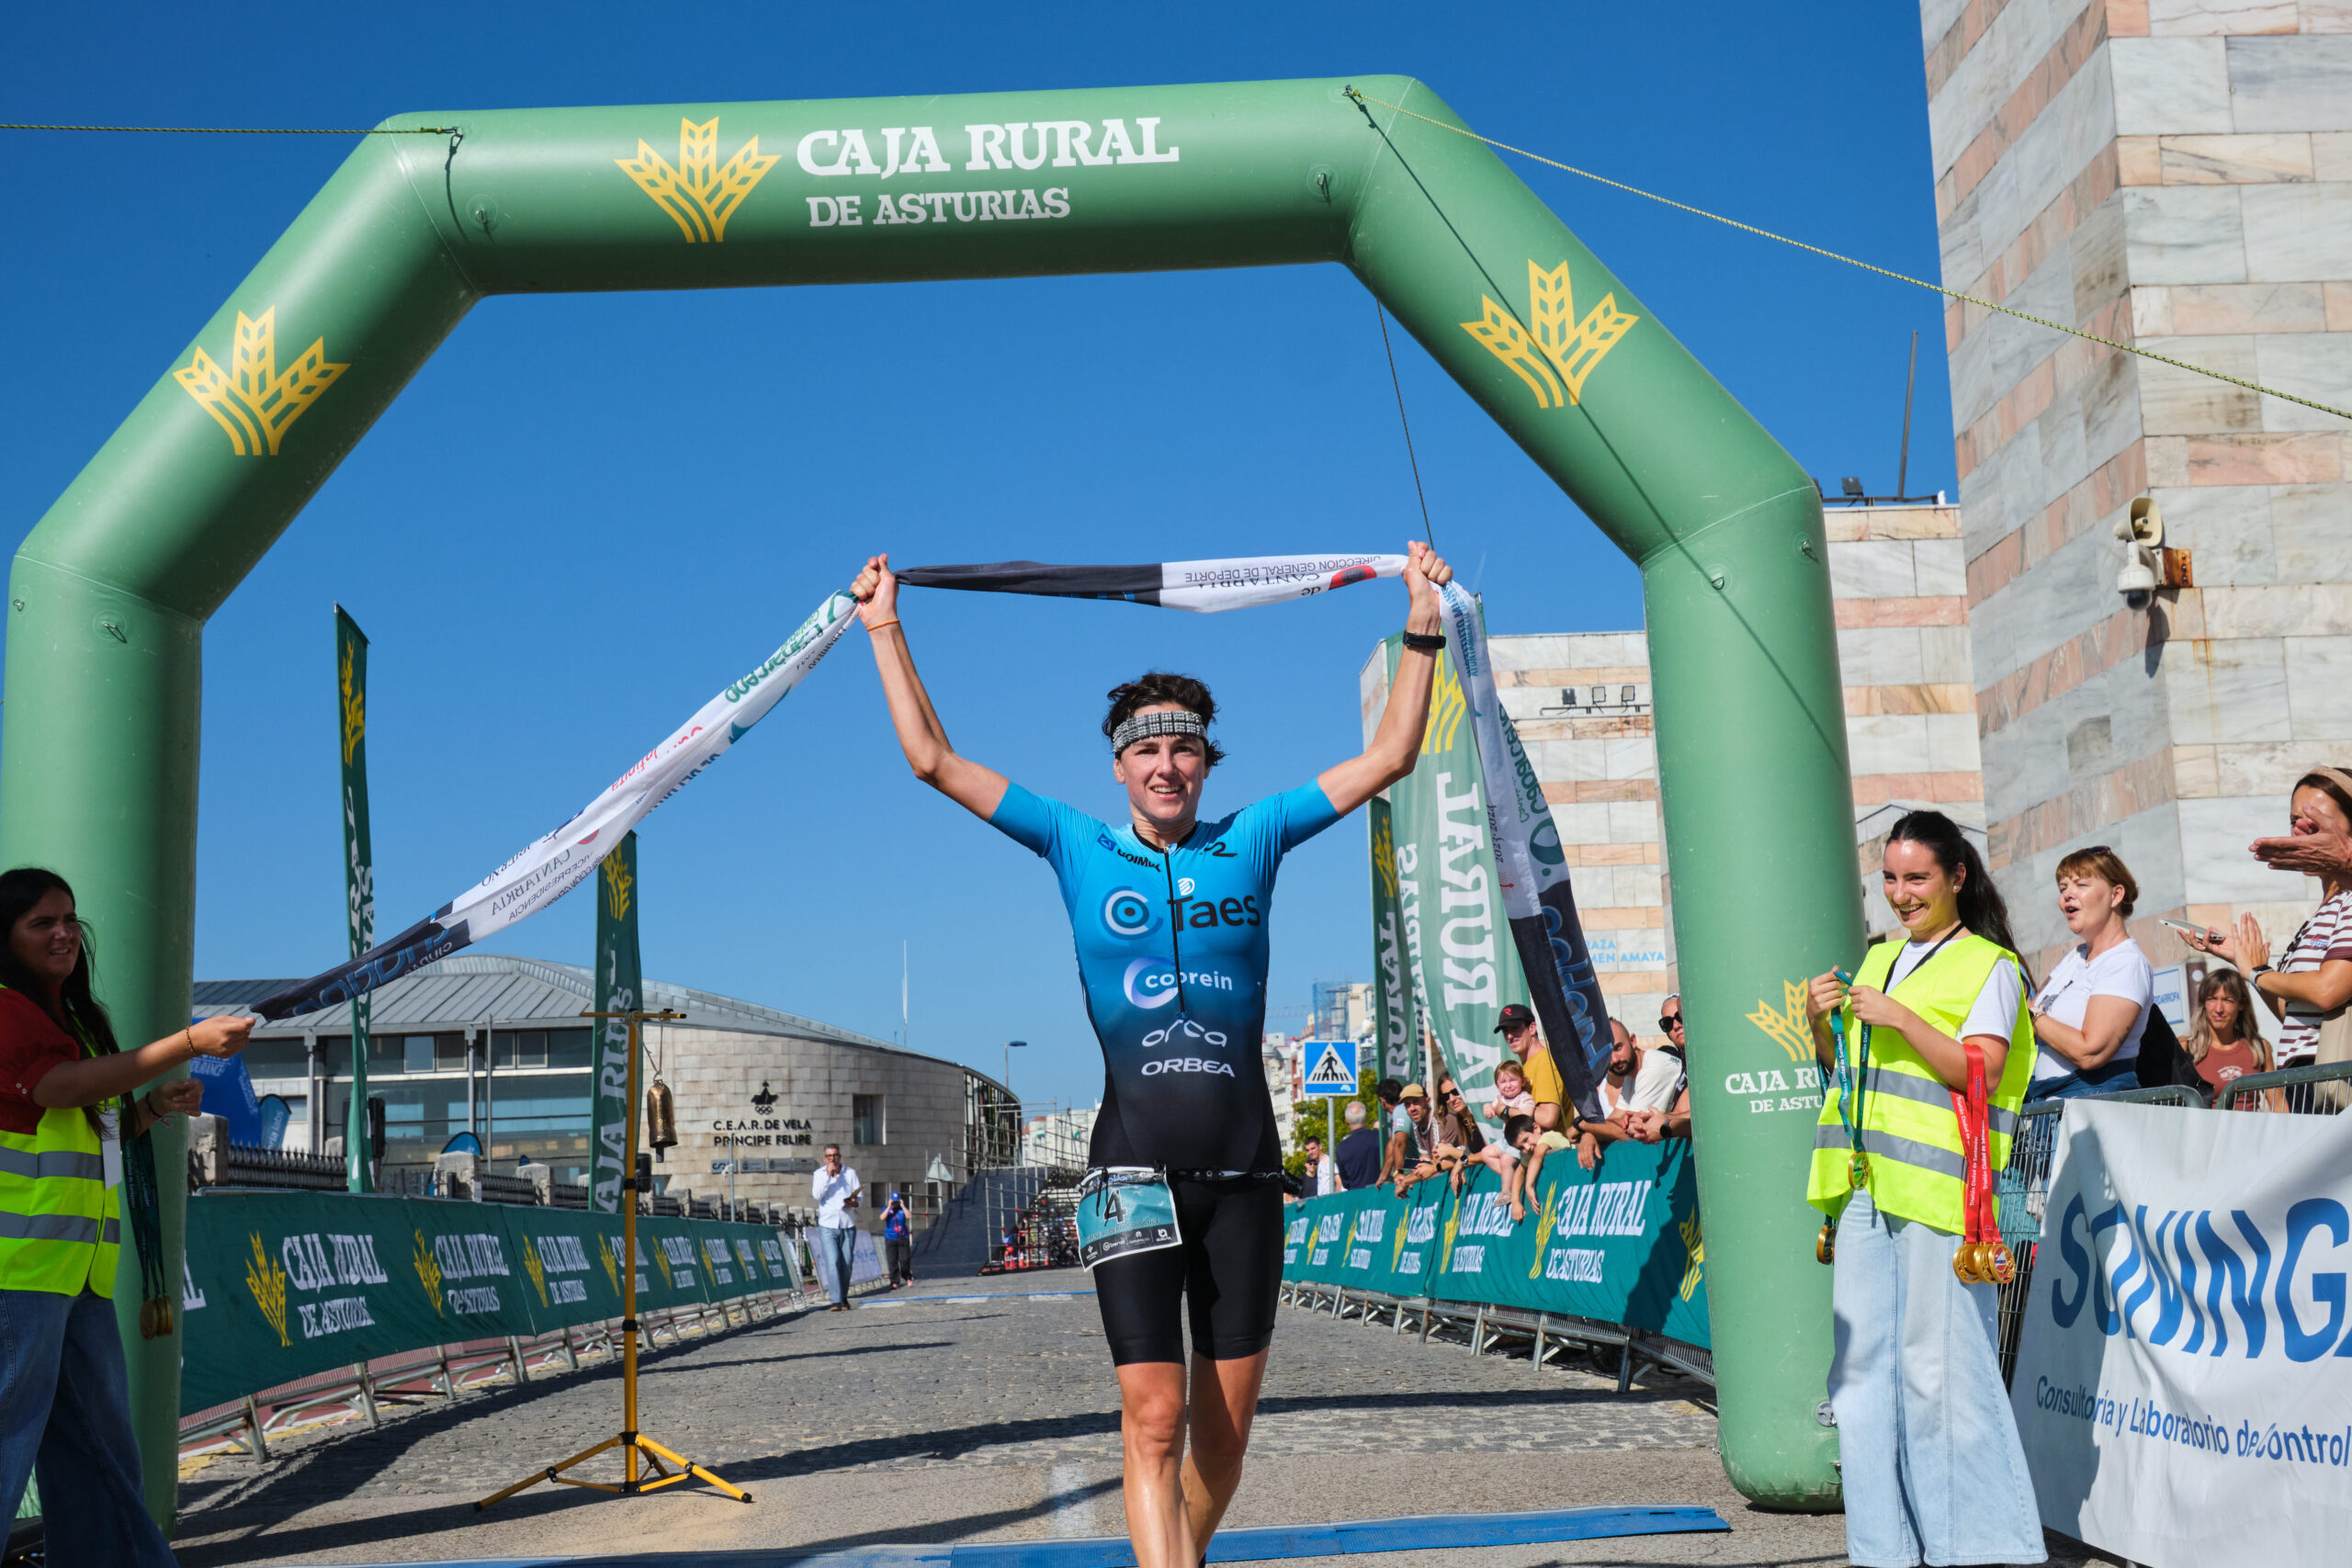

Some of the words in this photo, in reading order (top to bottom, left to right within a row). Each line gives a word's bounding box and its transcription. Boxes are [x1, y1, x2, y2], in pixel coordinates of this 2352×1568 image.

[796, 126, 951, 179] CAJA
[965, 117, 1180, 172] RURAL
[806, 195, 863, 227] DE
[872, 187, 1071, 225] ASTURIAS
[1184, 568, 1240, 583] DEPORTE
[1243, 567, 1260, 580] DE
[1261, 561, 1317, 579] GENERAL
[1166, 895, 1261, 933] Taes
[1620, 951, 1666, 963] AMAYA
[1379, 912, 1411, 1082] RURAL
[1141, 1019, 1227, 1048] orca
[1140, 1057, 1236, 1077] ORBEA
[1724, 1069, 1790, 1095] CAJA
[1749, 1099, 1774, 1114] DE
[713, 1120, 763, 1131] C.E.A.R.
[764, 1120, 781, 1130] DE
[783, 1119, 812, 1131] VELA
[714, 1133, 772, 1146] PRÍNCIPE
[775, 1134, 812, 1146] FELIPE
[1103, 1188, 1128, 1224] 4
[1557, 1185, 1594, 1240] CAJA
[1592, 1179, 1652, 1237] RURAL
[282, 1232, 334, 1294] CAJA
[435, 1235, 471, 1283] CAJA
[465, 1233, 511, 1279] RURAL
[2051, 1192, 2352, 1364] SONING
[2036, 1375, 2115, 1427] Consultoría
[2116, 1402, 2129, 1438] y
[2130, 1396, 2230, 1455] Laboratorio
